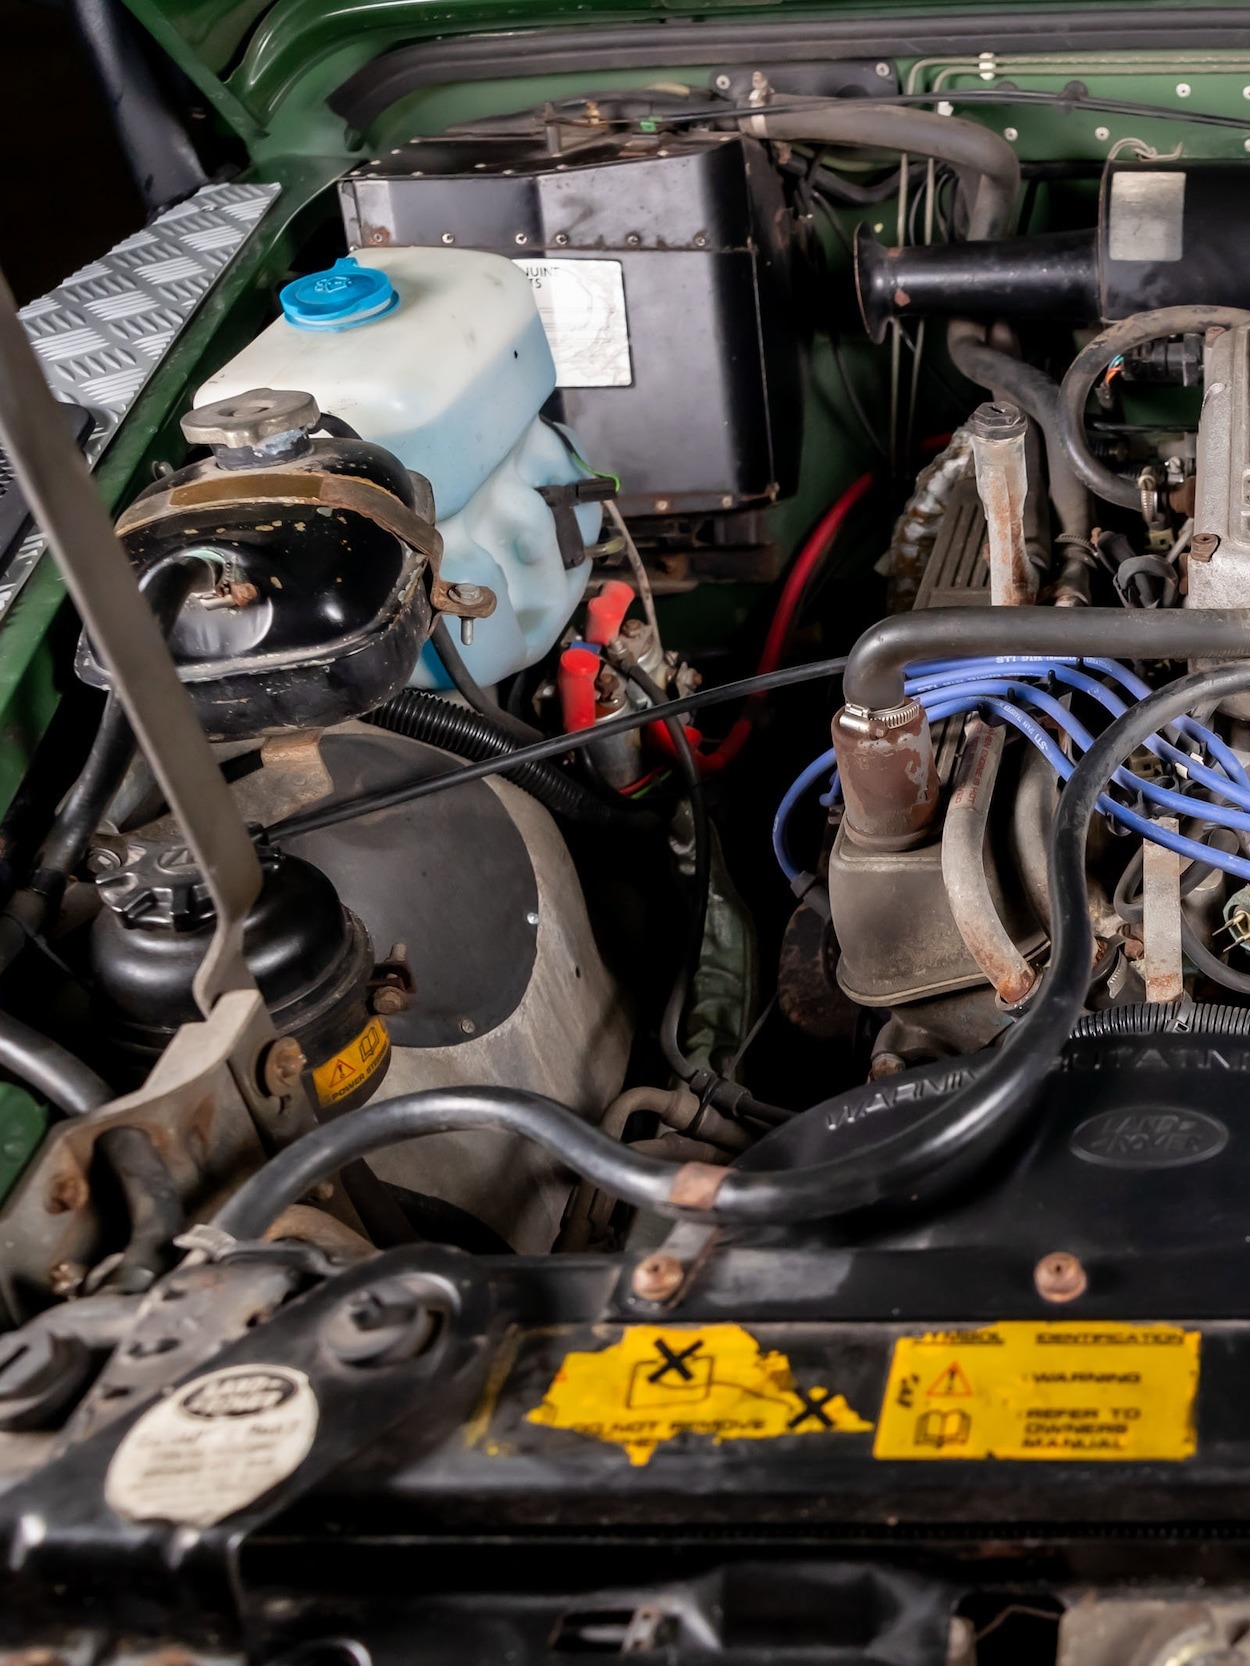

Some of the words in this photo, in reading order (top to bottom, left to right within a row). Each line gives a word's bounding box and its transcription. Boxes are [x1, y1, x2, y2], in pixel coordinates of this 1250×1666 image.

[996, 656, 1016, 664] STI
[1033, 733, 1048, 751] STI
[331, 1073, 365, 1100] POWER
[826, 1068, 978, 1131] WARNIN
[1031, 1371, 1141, 1384] WARNING
[1026, 1407, 1098, 1419] REFER
[1110, 1407, 1141, 1420] TO
[1024, 1422, 1128, 1435] OWNERS
[1021, 1436, 1123, 1450] MANUAL
